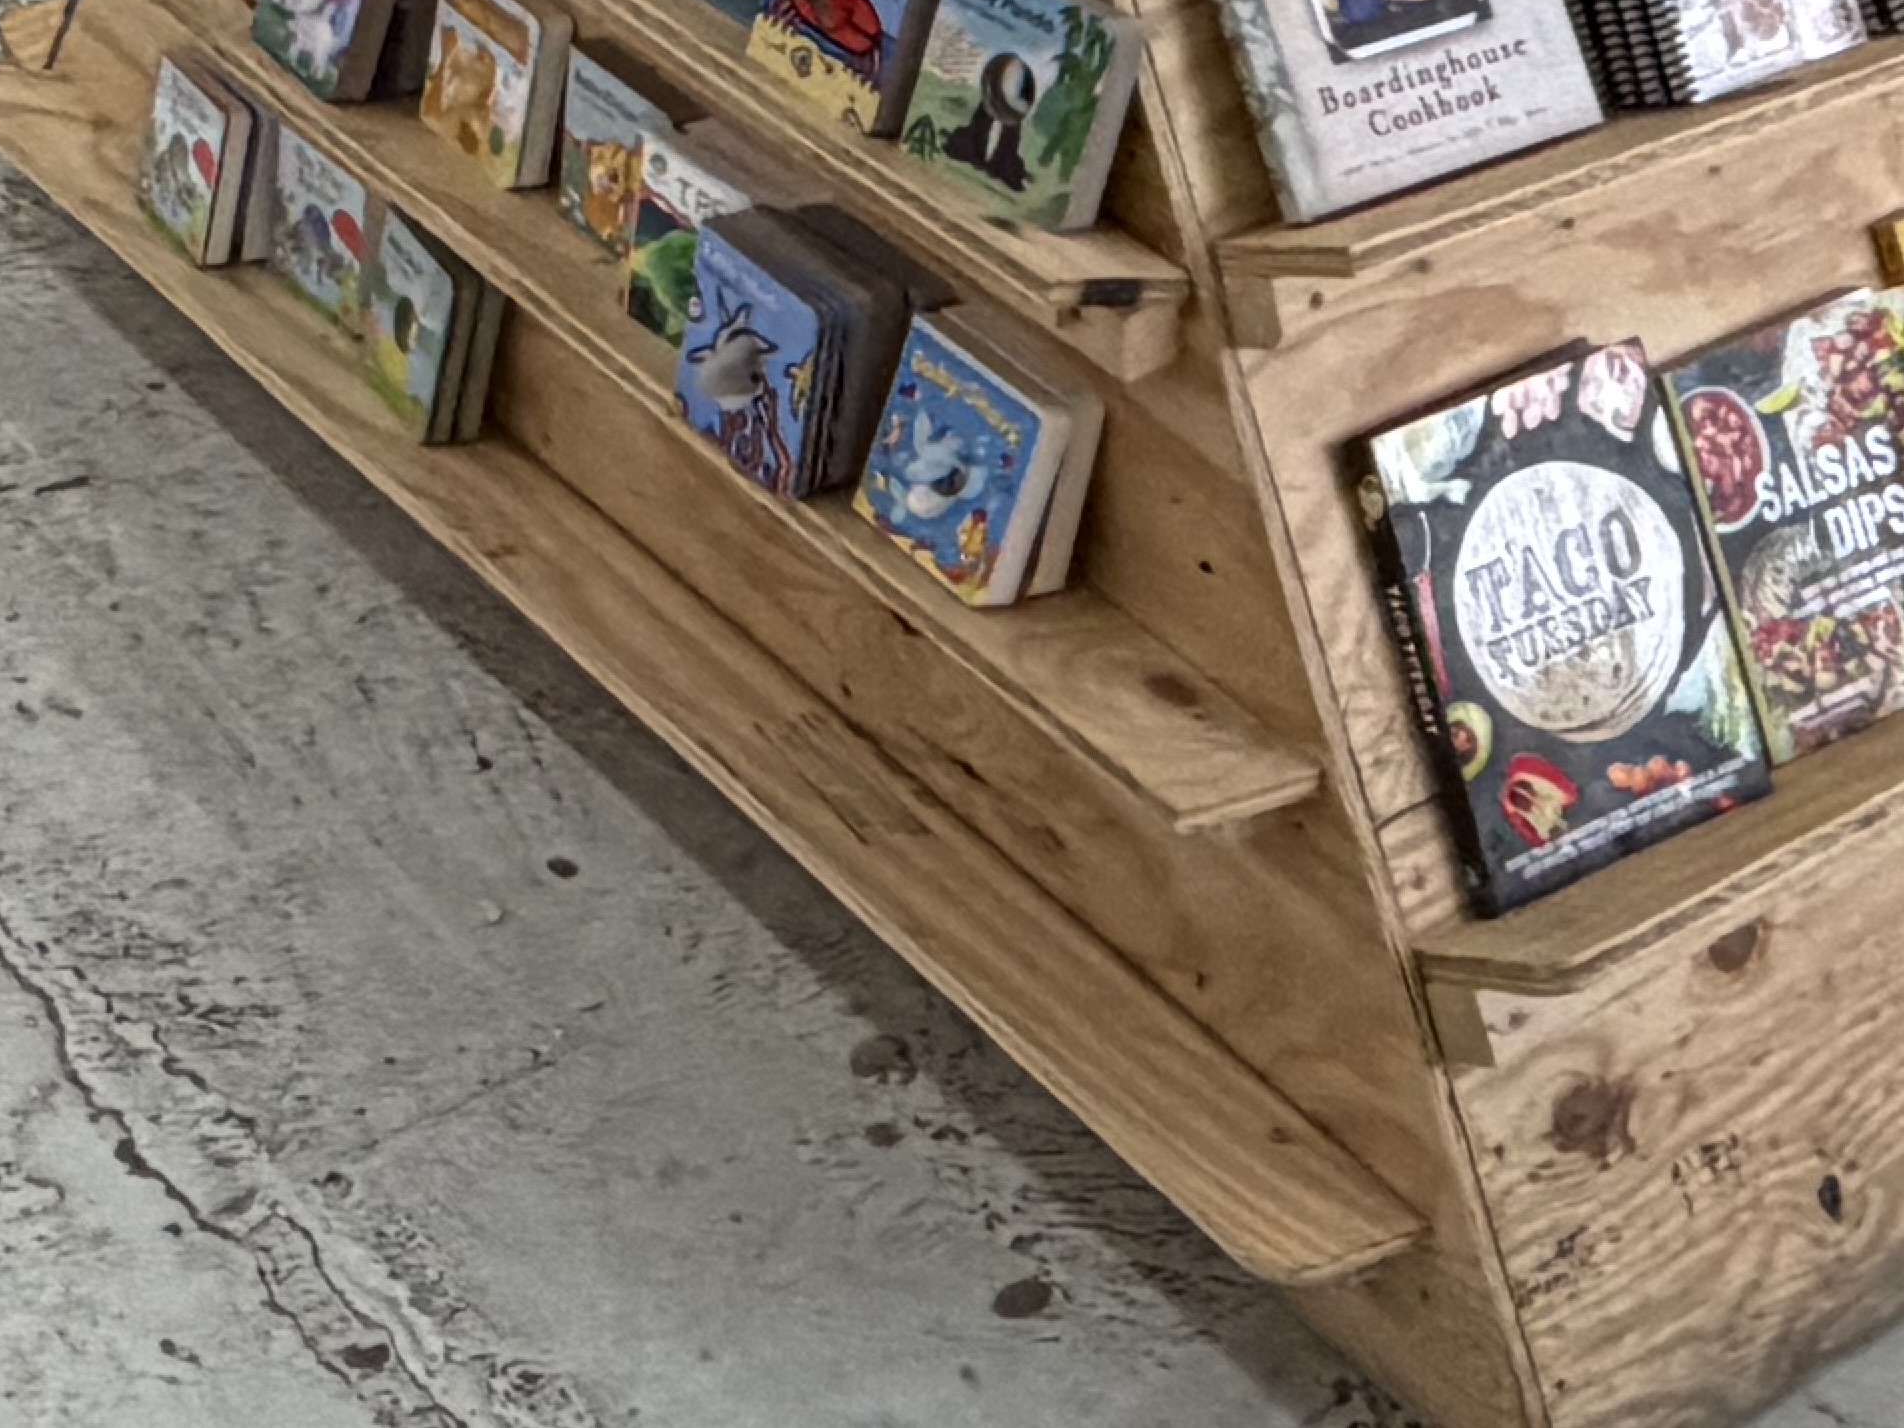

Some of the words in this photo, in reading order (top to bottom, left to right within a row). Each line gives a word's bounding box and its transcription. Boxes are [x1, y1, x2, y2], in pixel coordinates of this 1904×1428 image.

[1316, 38, 1527, 117] Boardinghouse
[1367, 78, 1502, 138] Cookbook
[1754, 424, 1896, 523] SALSAS
[1465, 506, 1644, 632] TACO
[1487, 575, 1658, 681] TUESDAY
